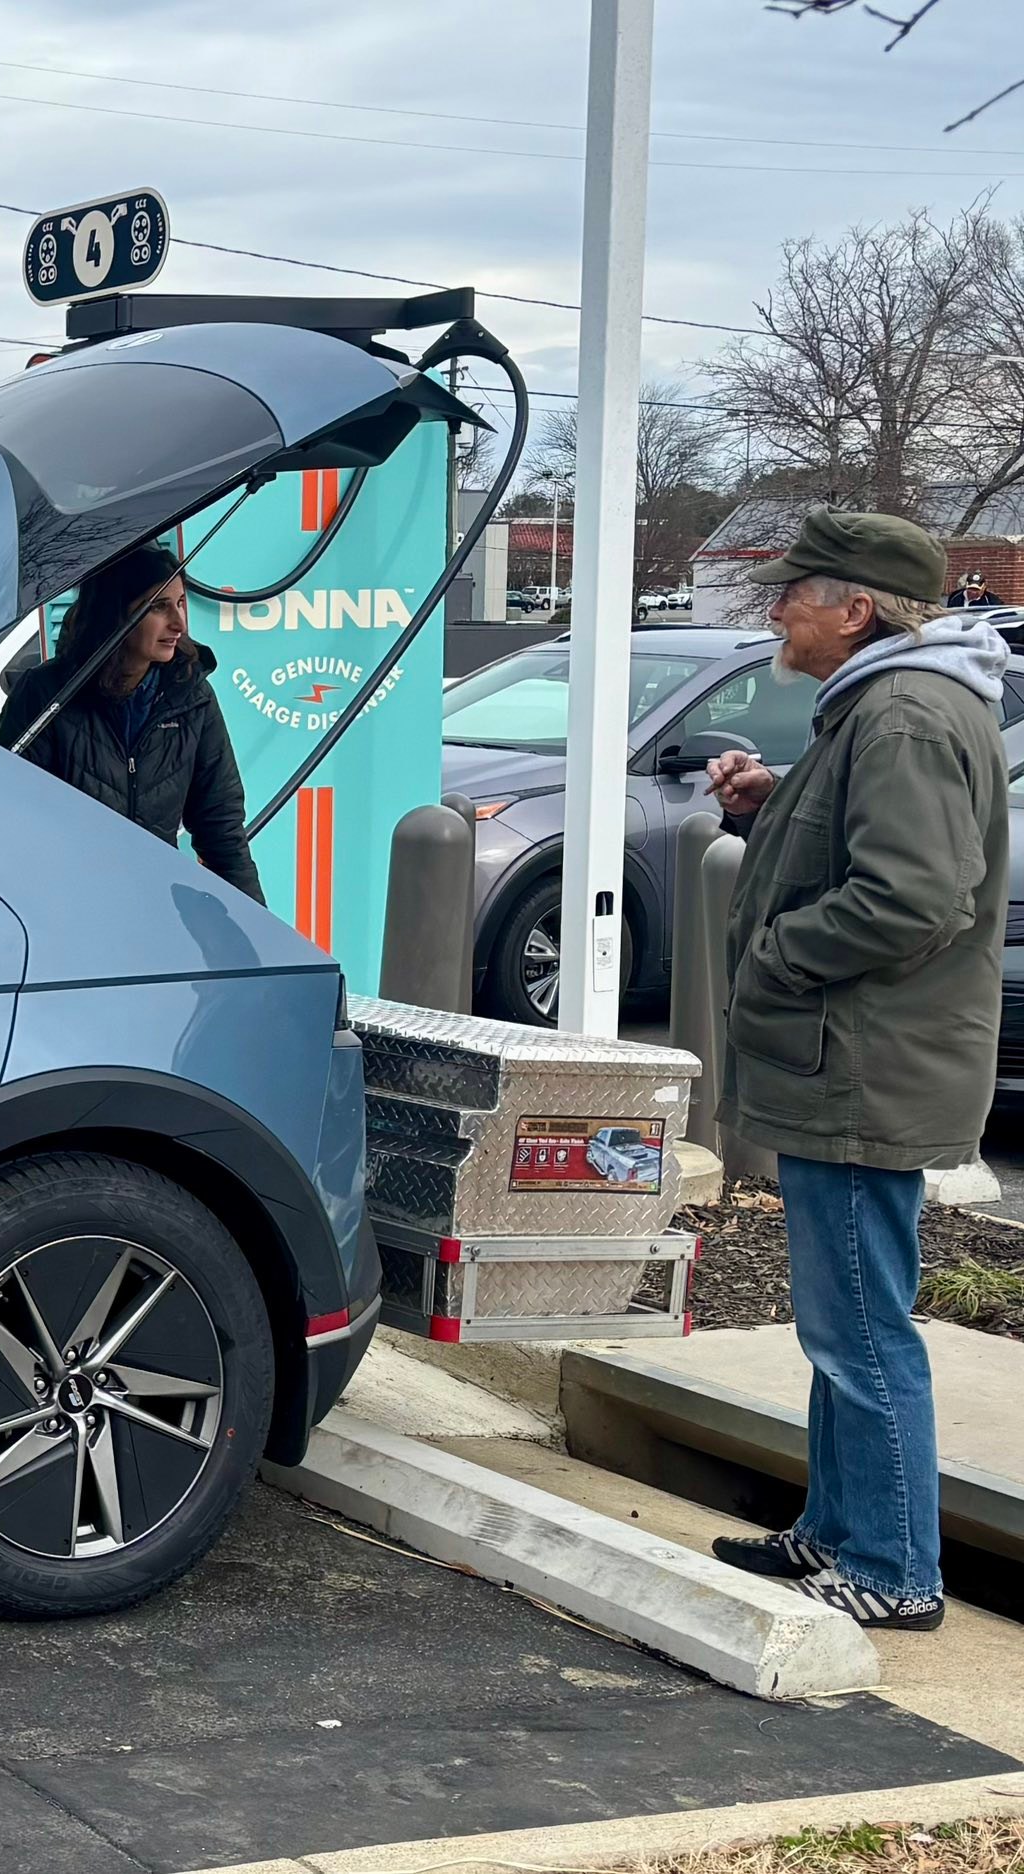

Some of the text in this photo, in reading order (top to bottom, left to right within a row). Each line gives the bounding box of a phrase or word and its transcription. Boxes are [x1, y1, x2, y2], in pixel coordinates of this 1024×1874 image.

[85, 228, 102, 268] 4
[219, 587, 414, 632] IONNA
[271, 656, 363, 686] GENUINE
[232, 667, 301, 729] CHARGE
[898, 1601, 938, 1616] adidas
